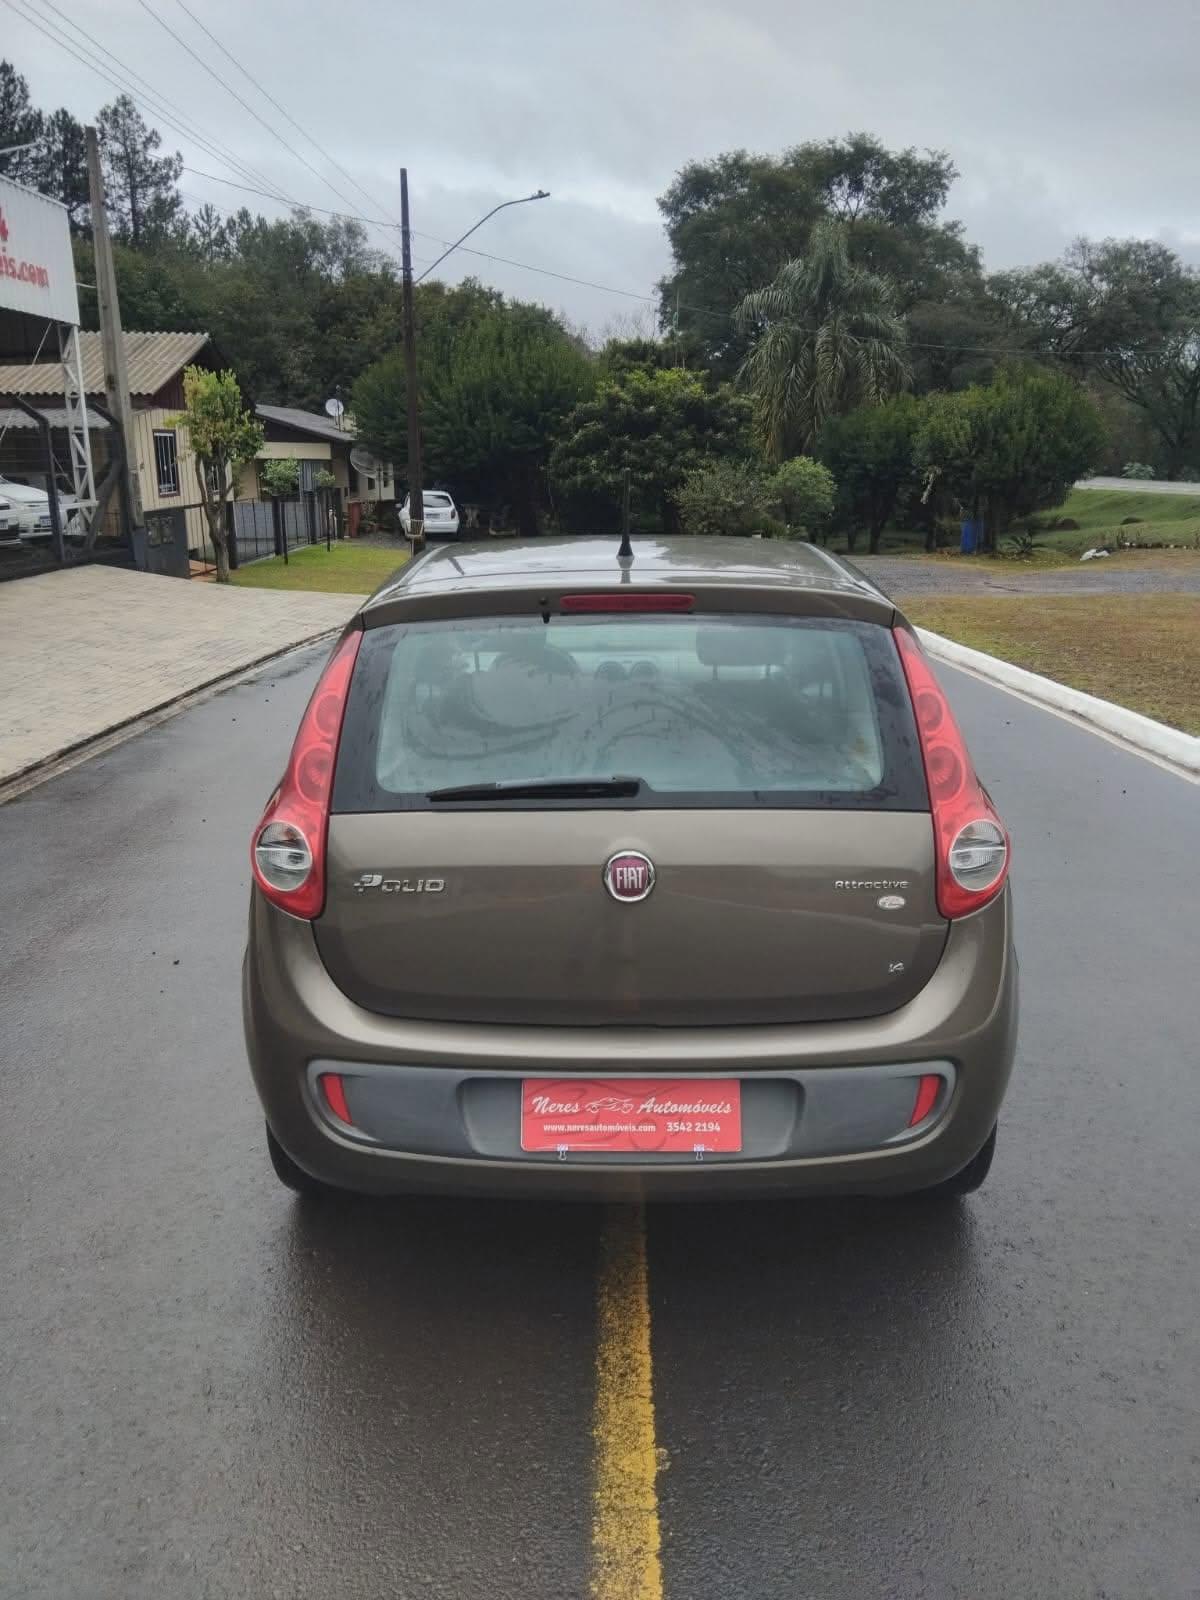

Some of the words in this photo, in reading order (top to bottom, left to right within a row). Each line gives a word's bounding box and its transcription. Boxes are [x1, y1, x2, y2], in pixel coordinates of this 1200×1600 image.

[615, 866, 645, 889] FIAT
[531, 1096, 580, 1115] Neres
[636, 1095, 733, 1115] Automóveis
[666, 1121, 693, 1133] 3542
[694, 1121, 721, 1133] 2194
